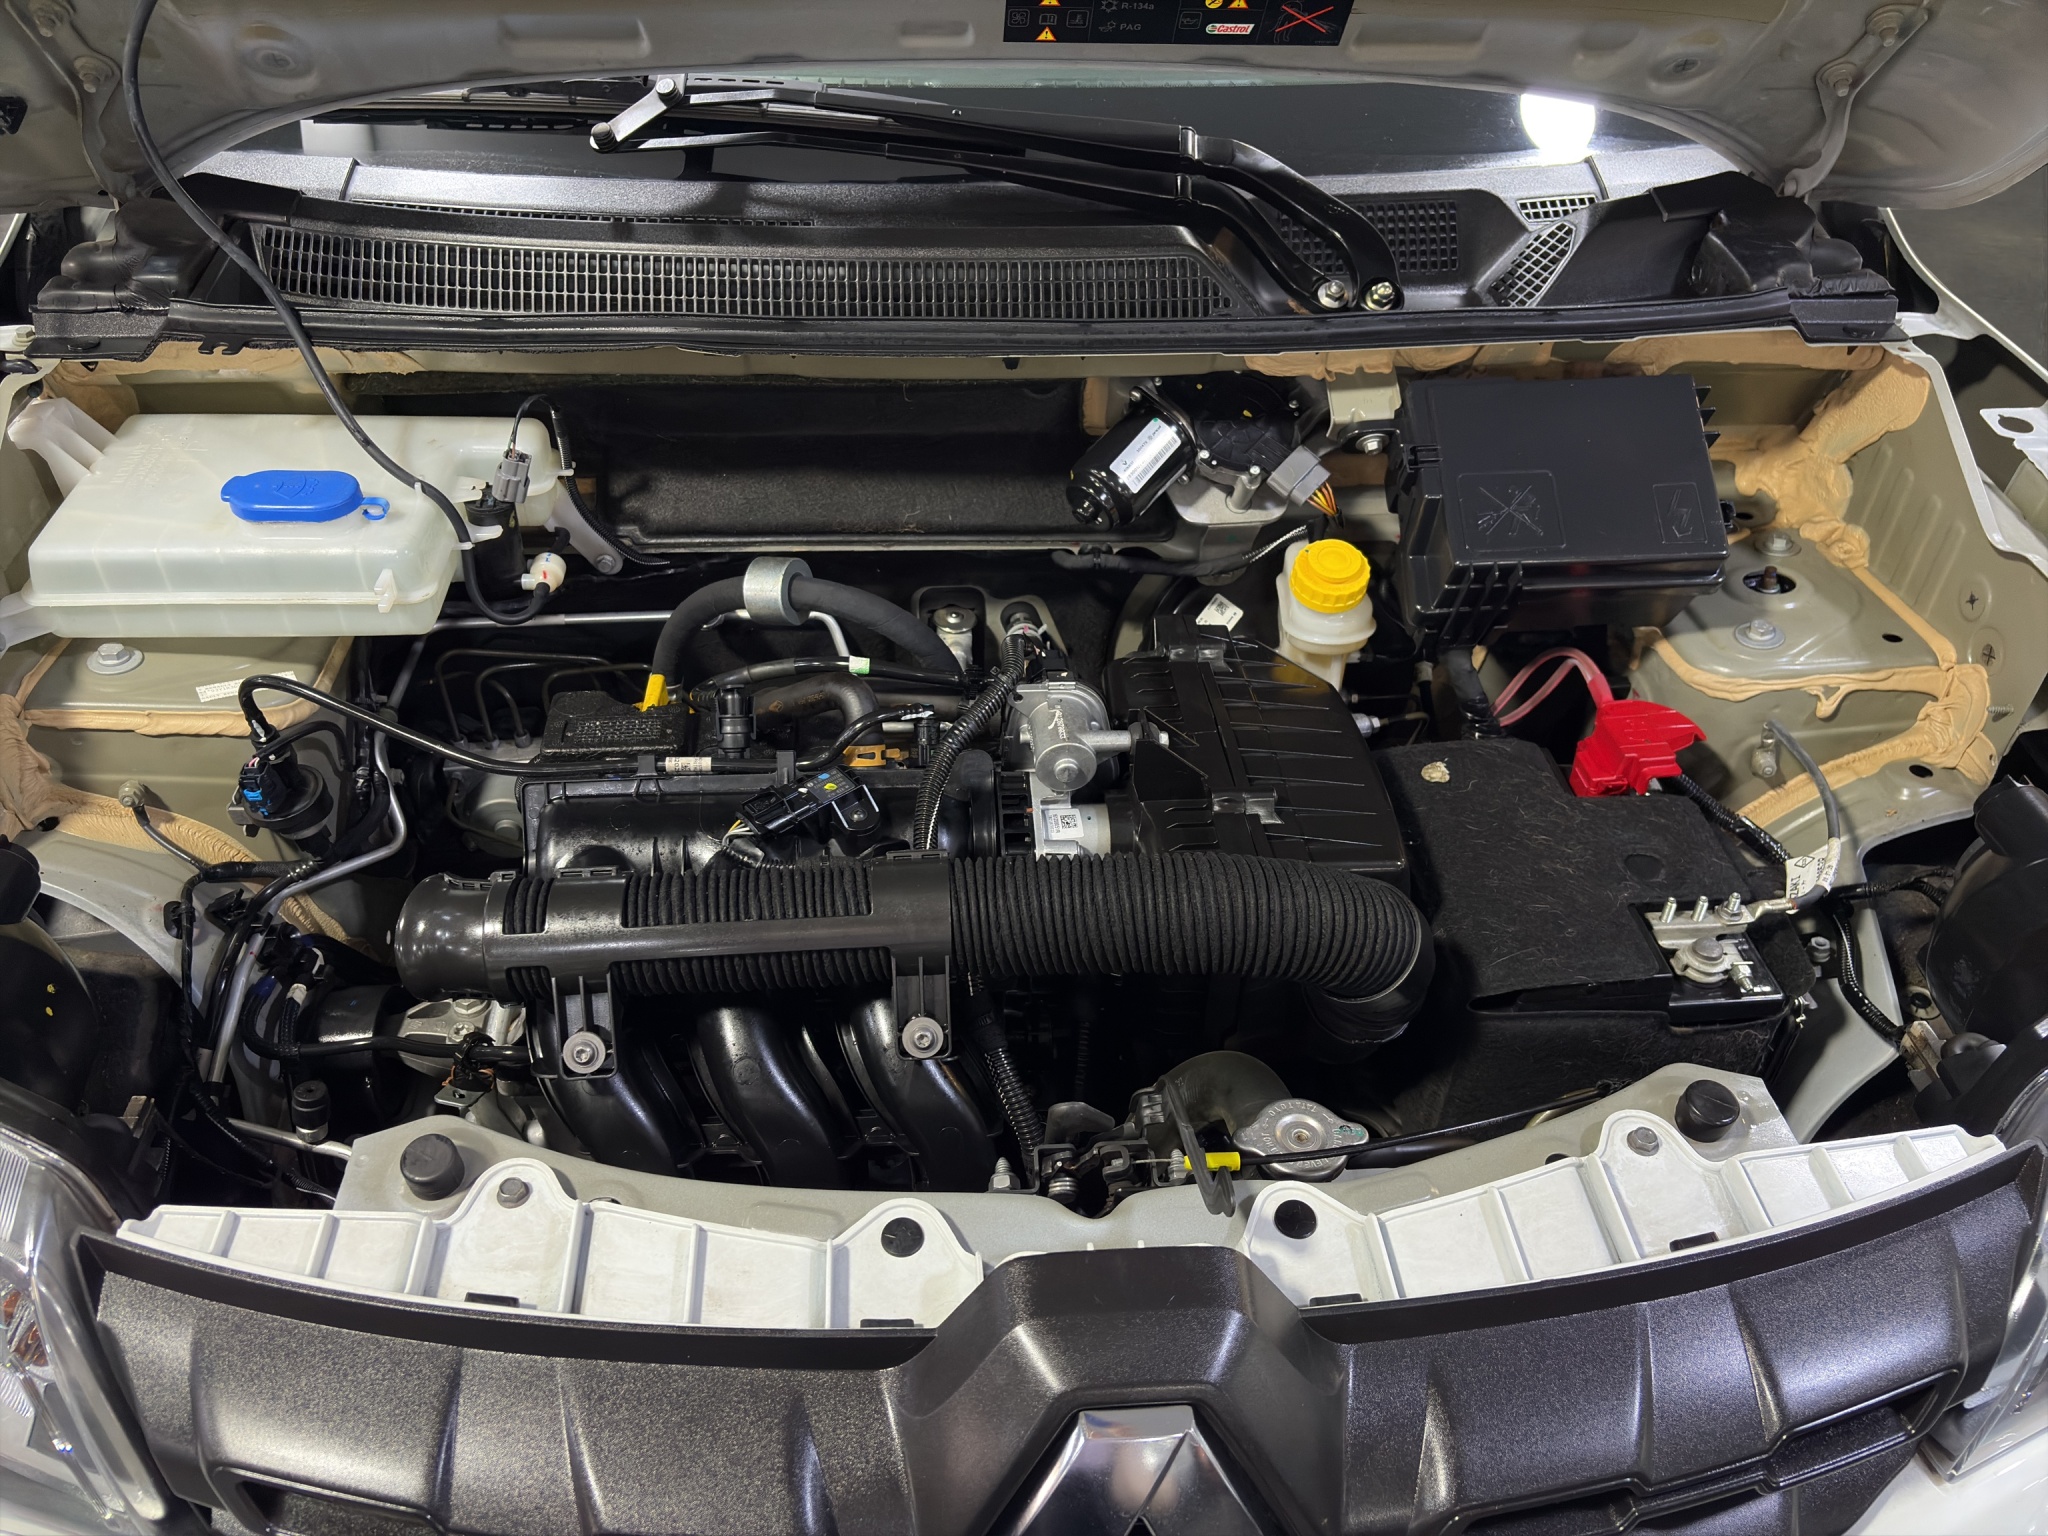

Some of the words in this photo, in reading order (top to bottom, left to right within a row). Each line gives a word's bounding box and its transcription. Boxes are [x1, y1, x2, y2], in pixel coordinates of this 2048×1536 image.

[1121, 2, 1154, 10] R-134a
[1120, 23, 1142, 31] PAG
[1216, 24, 1250, 34] Castrol
